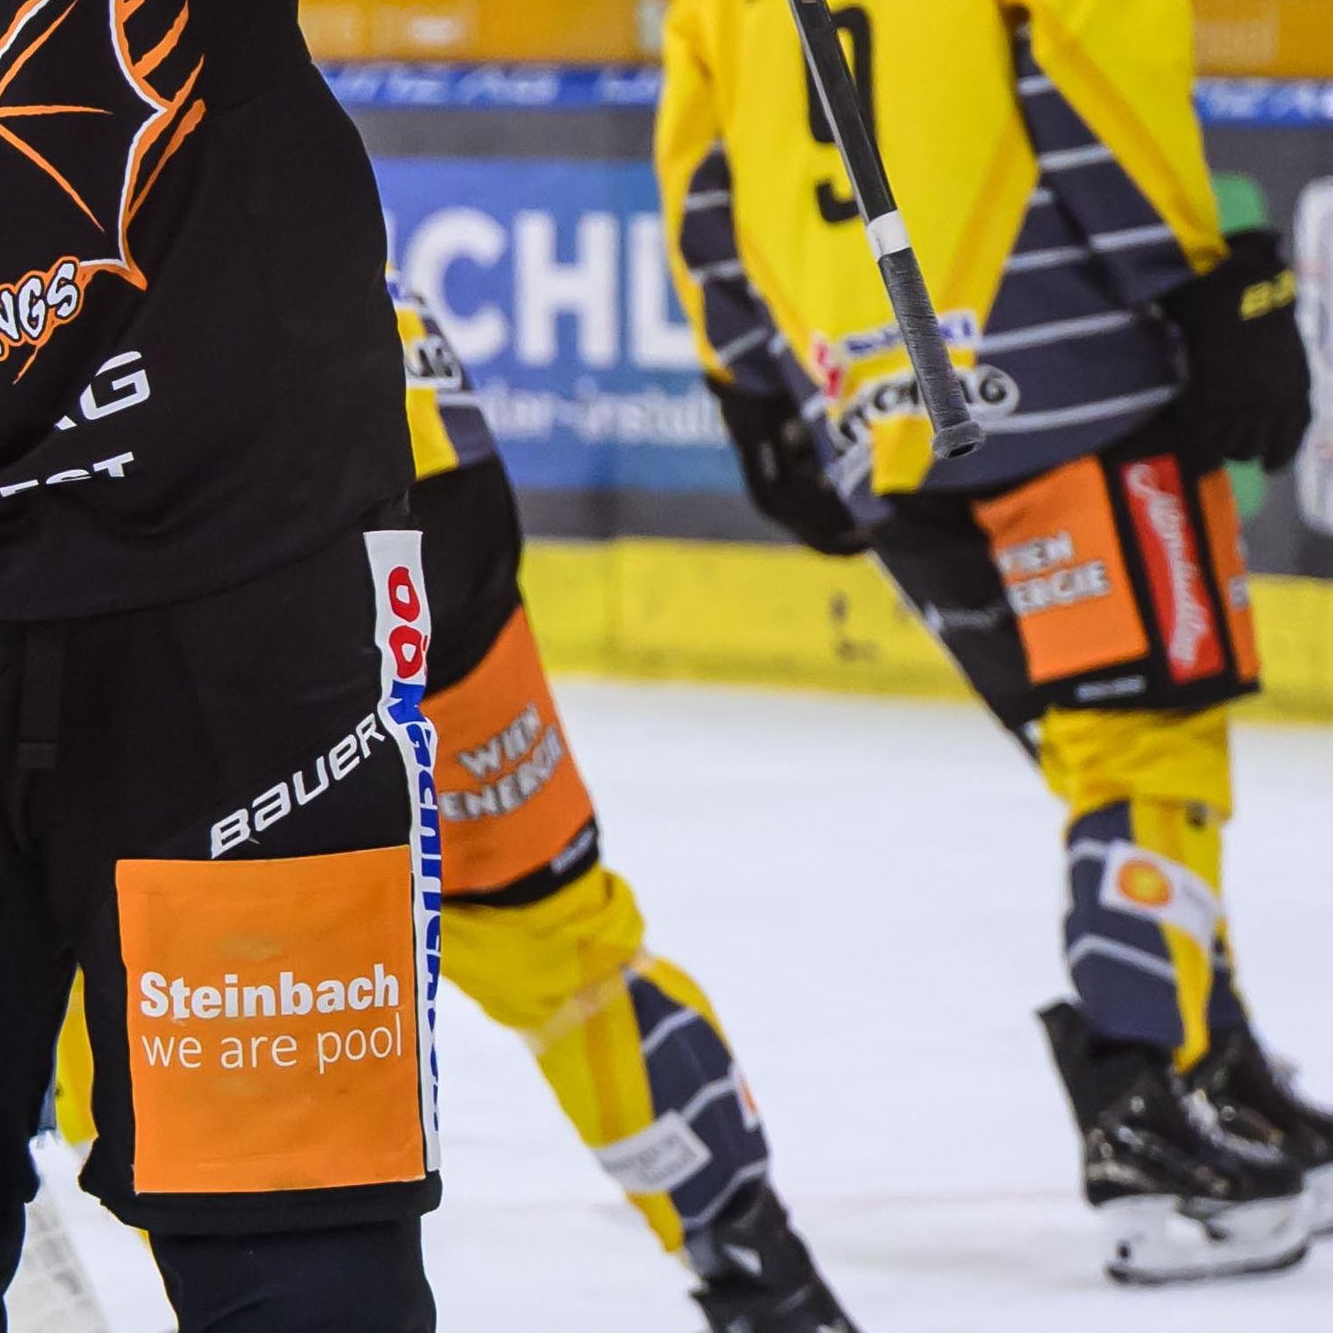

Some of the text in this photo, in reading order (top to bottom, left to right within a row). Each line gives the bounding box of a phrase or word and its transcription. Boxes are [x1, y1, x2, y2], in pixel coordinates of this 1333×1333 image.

[138, 962, 401, 1021] Steinbach
[140, 1010, 403, 1076] we are pool
